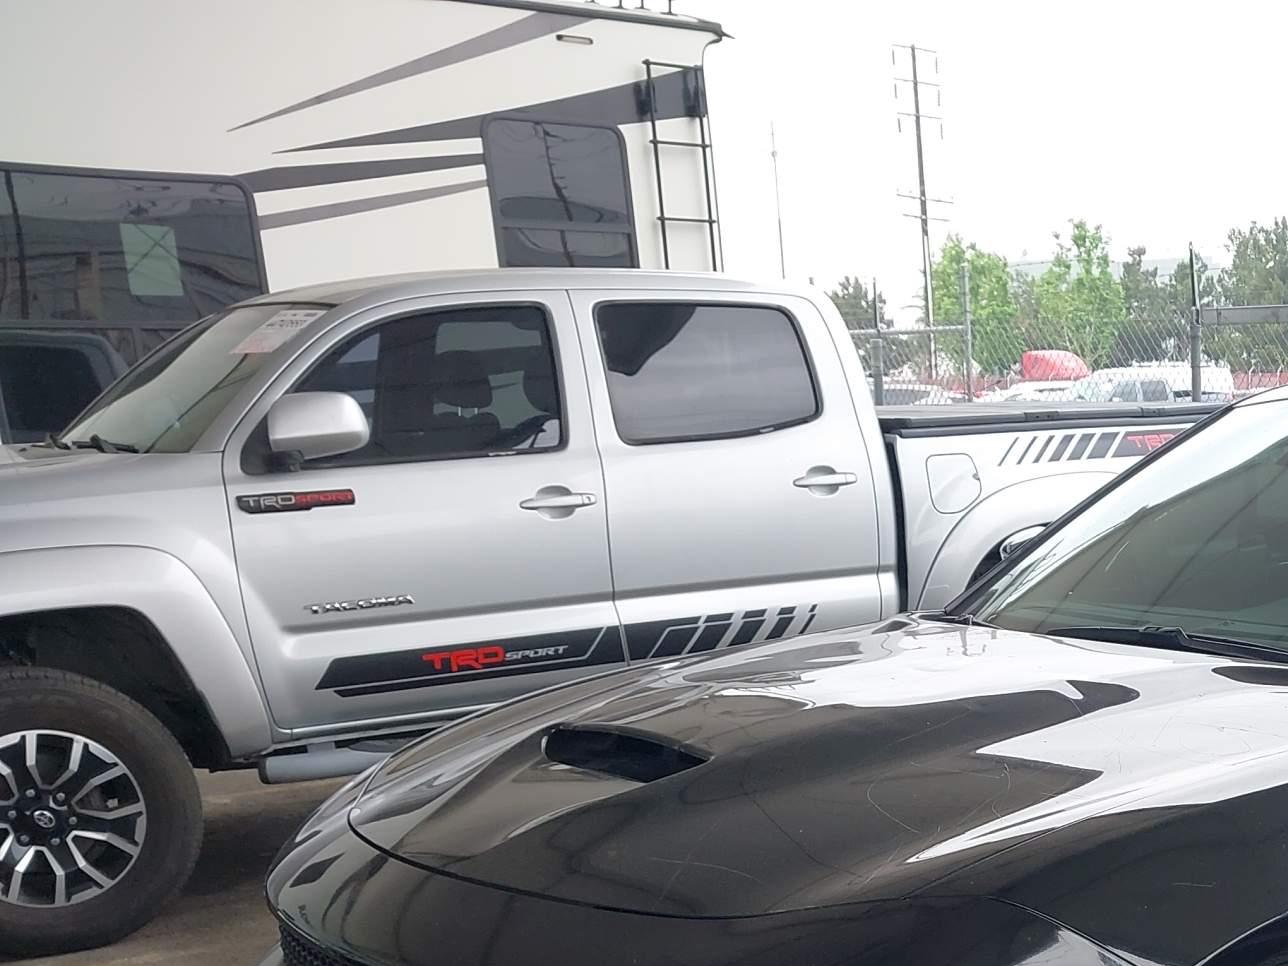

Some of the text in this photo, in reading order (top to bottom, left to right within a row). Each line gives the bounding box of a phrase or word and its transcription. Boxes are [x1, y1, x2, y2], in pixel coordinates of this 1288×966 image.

[242, 494, 295, 509] TRD
[304, 595, 415, 614] TACOMA
[422, 645, 568, 672] TRD SPORT
